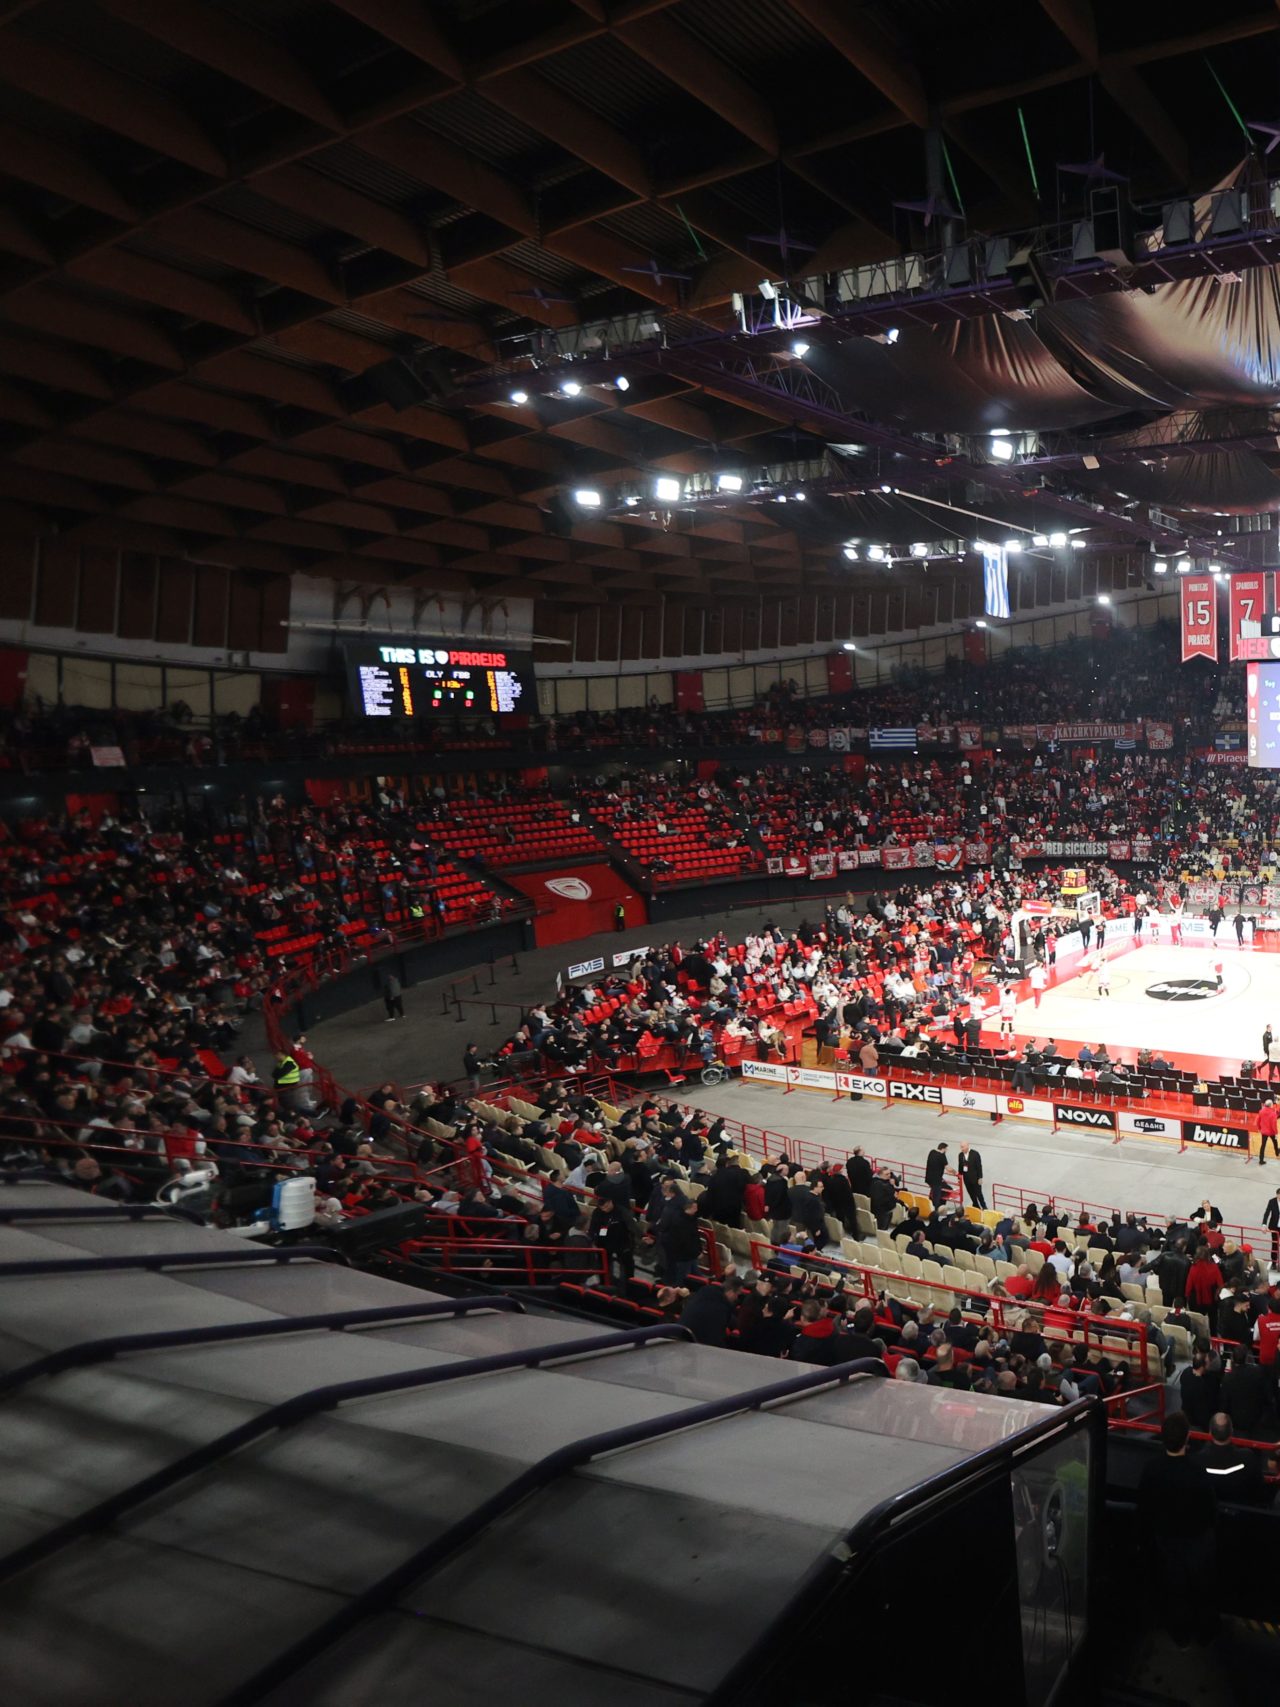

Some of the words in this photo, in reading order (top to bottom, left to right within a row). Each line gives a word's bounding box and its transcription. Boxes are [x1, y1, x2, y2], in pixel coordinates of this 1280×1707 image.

[1187, 601, 1210, 626] 15
[1240, 599, 1254, 621] 7
[379, 646, 416, 664] THIS
[418, 649, 435, 665] IS
[449, 651, 507, 667] PIRAEUS
[425, 670, 444, 679] OLY
[1046, 842, 1063, 855] RED
[1065, 842, 1108, 855] SICKNESS
[1064, 878, 1075, 886] 24
[570, 960, 602, 976] FMS
[991, 965, 1020, 974] NVA
[754, 1066, 777, 1075] MARINE
[852, 1079, 885, 1093] EKO
[890, 1082, 941, 1103] AXE
[963, 1097, 976, 1108] Skip
[1008, 1100, 1023, 1109] alfa
[1057, 1109, 1112, 1126] NOVA
[1135, 1122, 1163, 1130] ΔΕΔΔΗΕ
[1193, 1126, 1239, 1147] bwin
